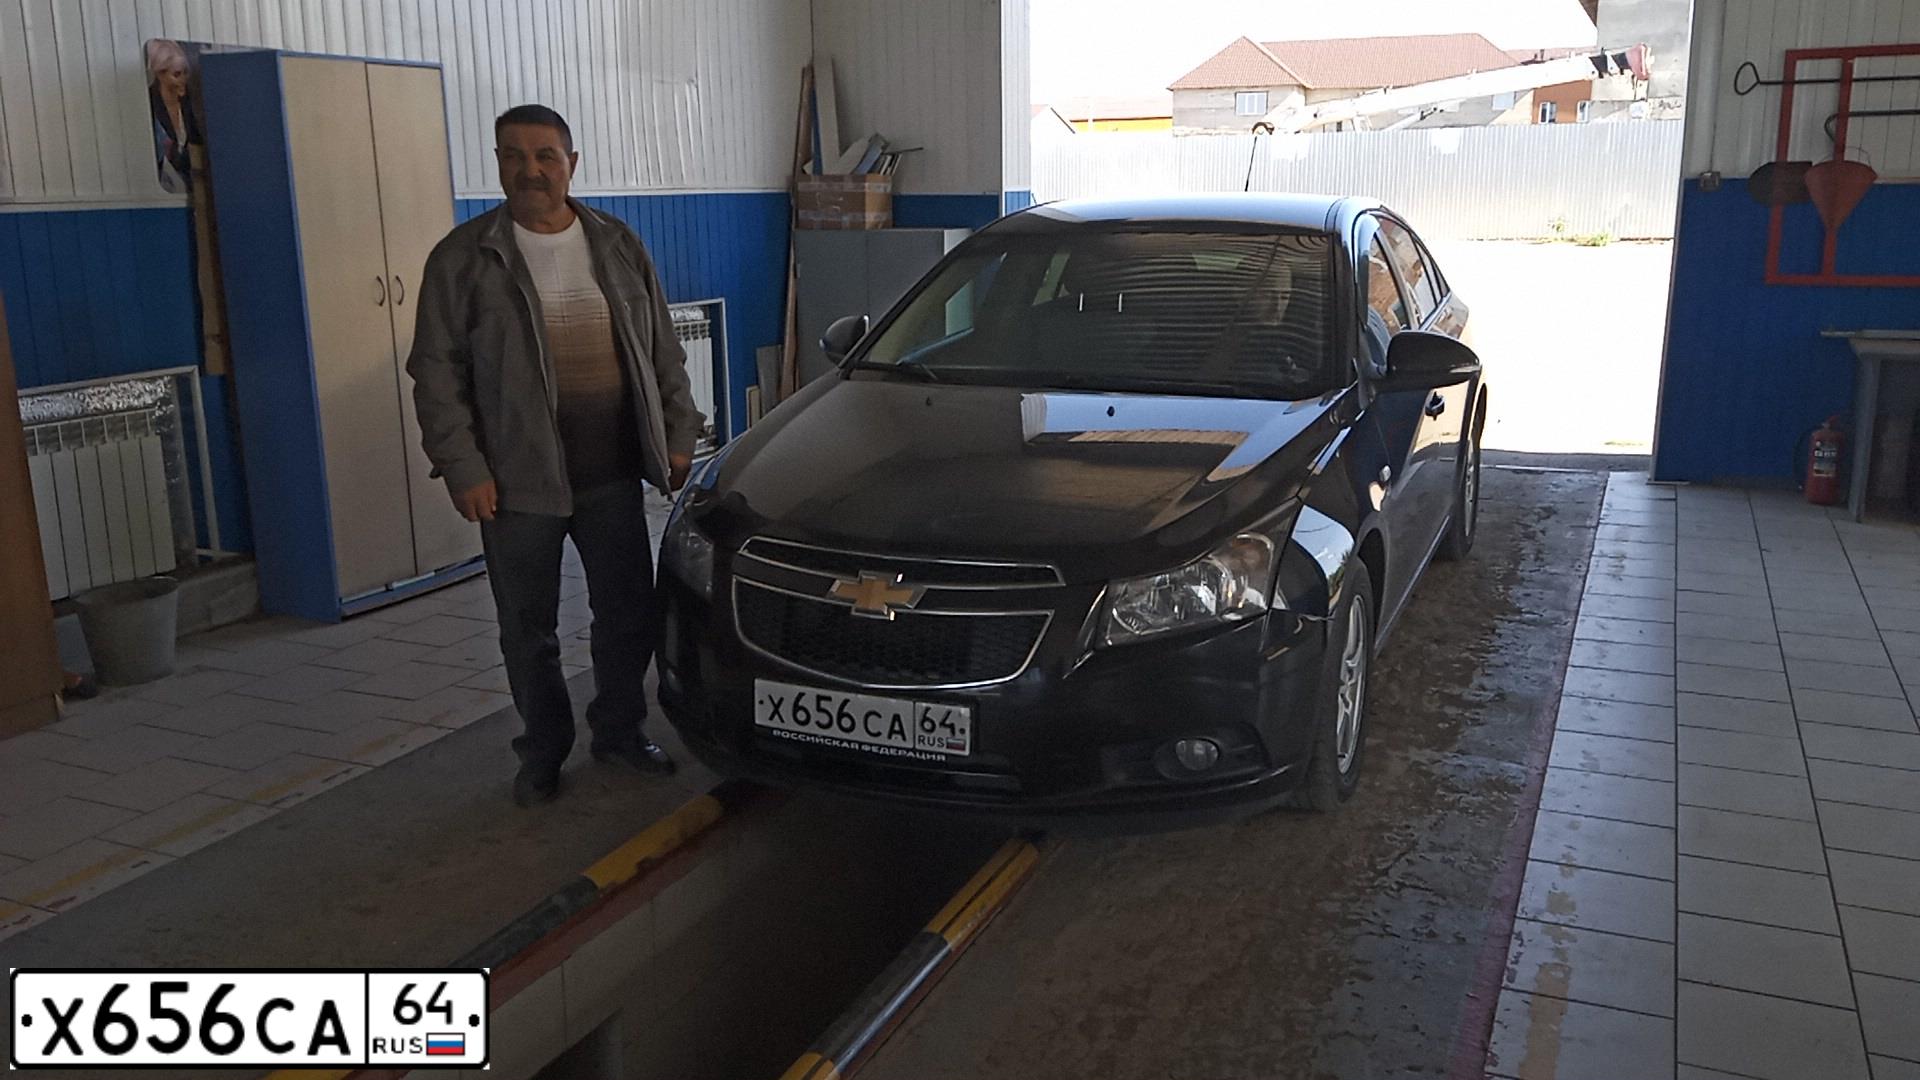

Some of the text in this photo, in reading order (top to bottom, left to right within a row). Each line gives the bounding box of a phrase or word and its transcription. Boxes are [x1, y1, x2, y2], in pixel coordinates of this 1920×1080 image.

[921, 706, 956, 737] 64
[772, 729, 947, 762] РОССИЙСКАЯ ФЕДЕРАЦИЯ
[917, 734, 945, 748] RUS
